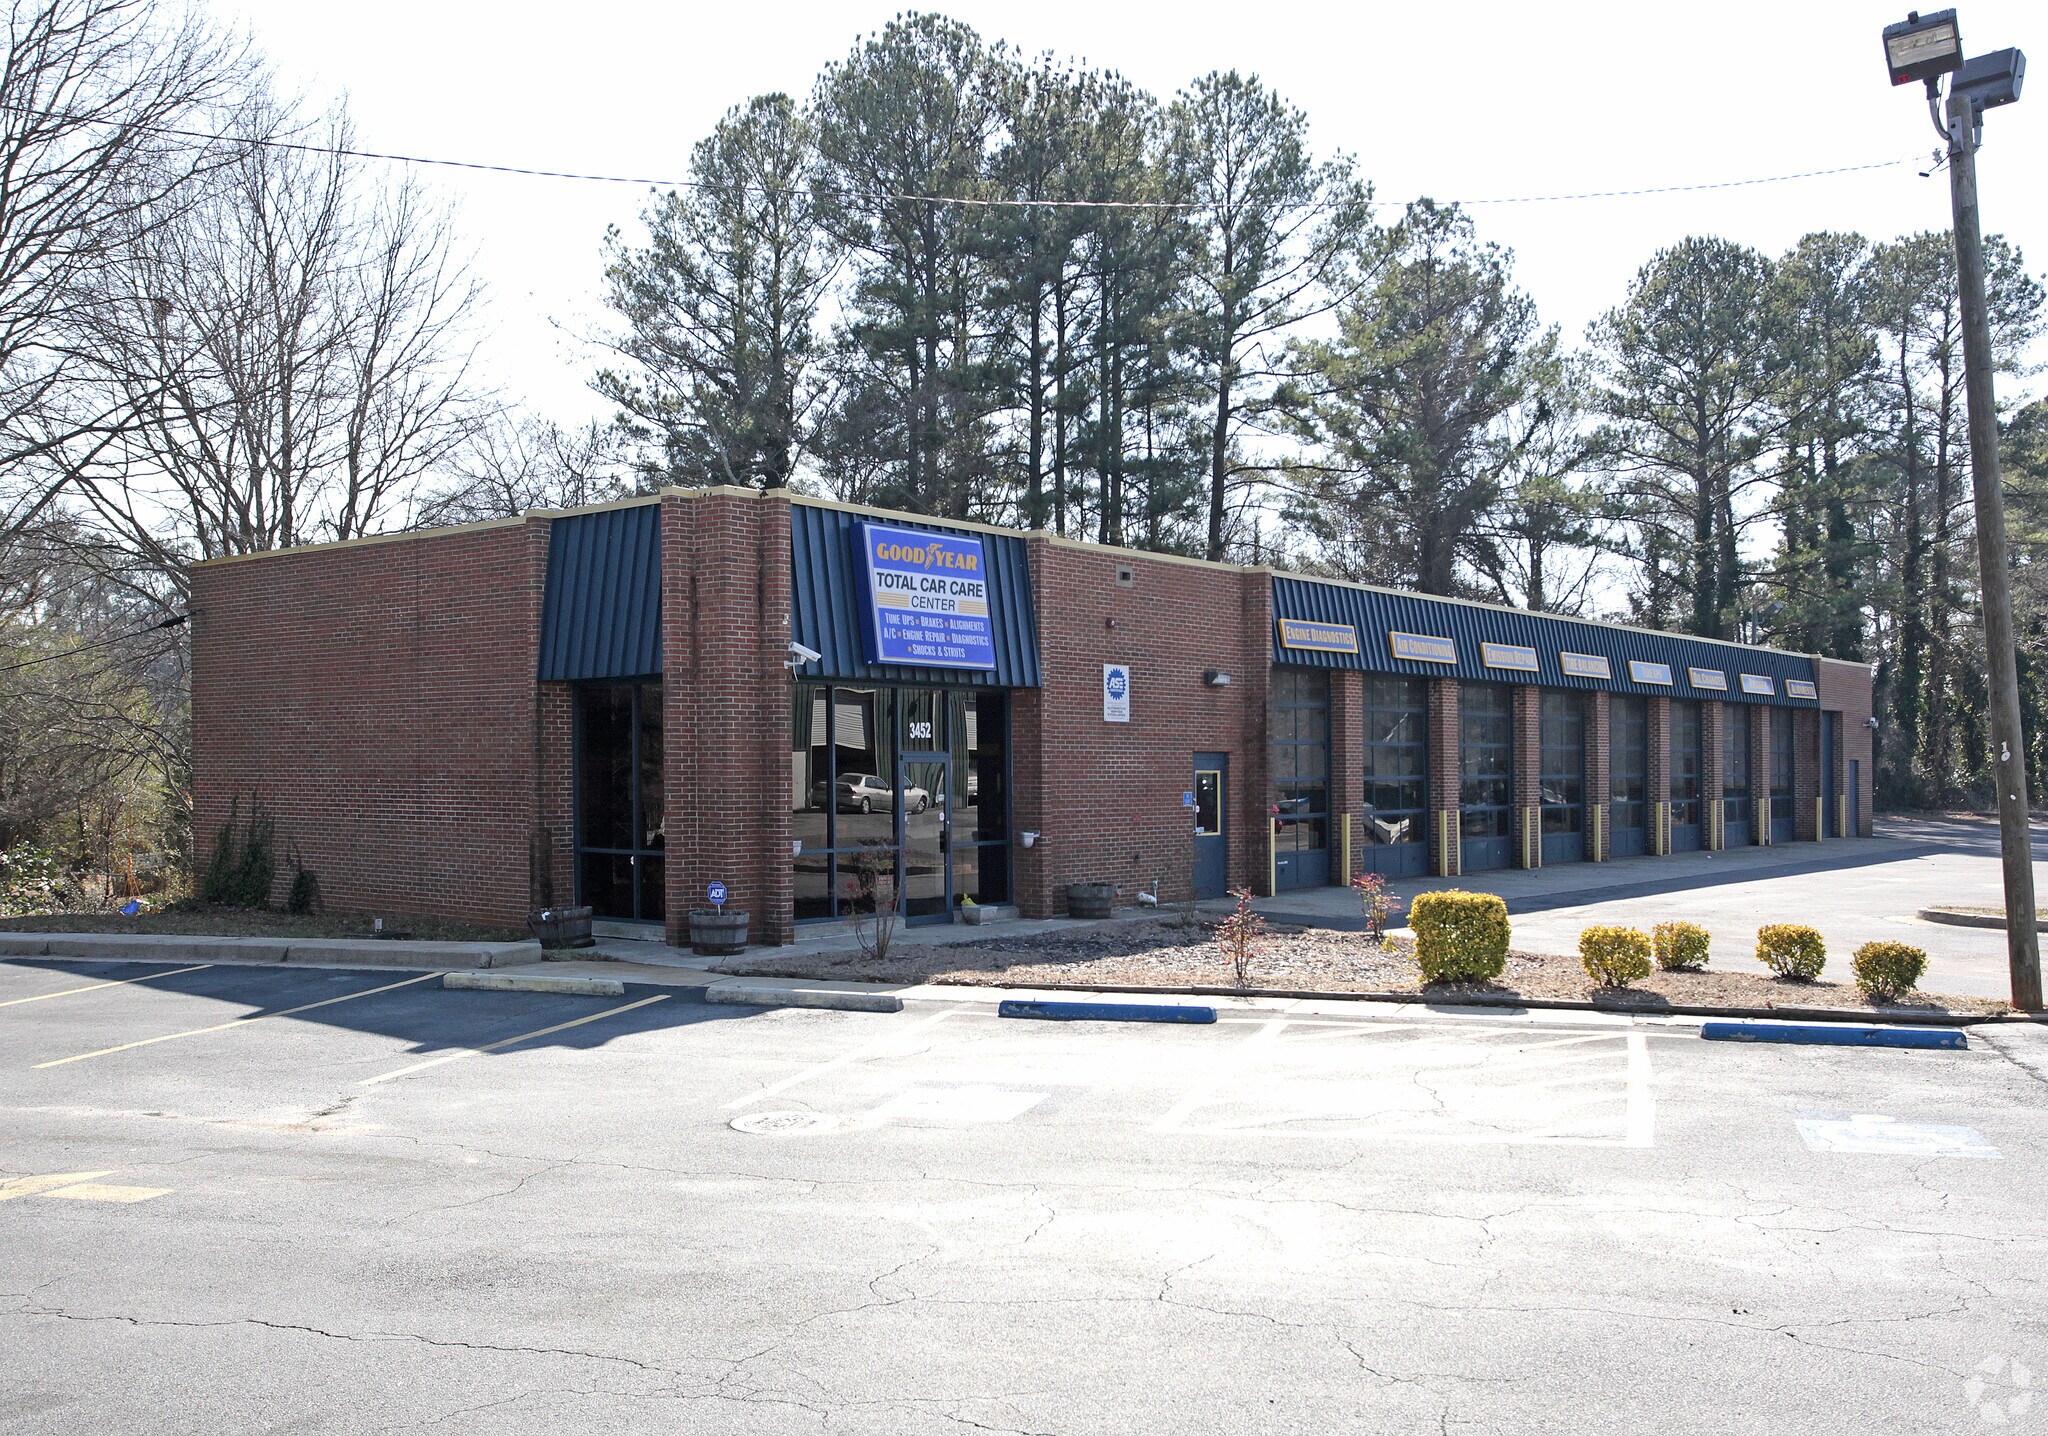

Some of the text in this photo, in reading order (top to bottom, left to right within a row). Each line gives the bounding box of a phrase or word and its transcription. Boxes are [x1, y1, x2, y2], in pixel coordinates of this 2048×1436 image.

[876, 572, 983, 598] TOTAL CAR CARE
[911, 595, 956, 612] CENTER
[884, 612, 985, 632] TUNE UPS BRAKES ALIGNMENTS
[883, 627, 989, 646] A/C ENGINE REPAIR DIAGNOSTICS
[1285, 626, 1353, 645] ENGINE DIAGNOSTICS
[912, 644, 966, 658] SHOCKS & STRUTS
[1397, 637, 1452, 657] AIR CONDITIONING
[1109, 677, 1124, 689] ASE
[909, 722, 932, 739] 3452
[710, 888, 724, 898] ADT
